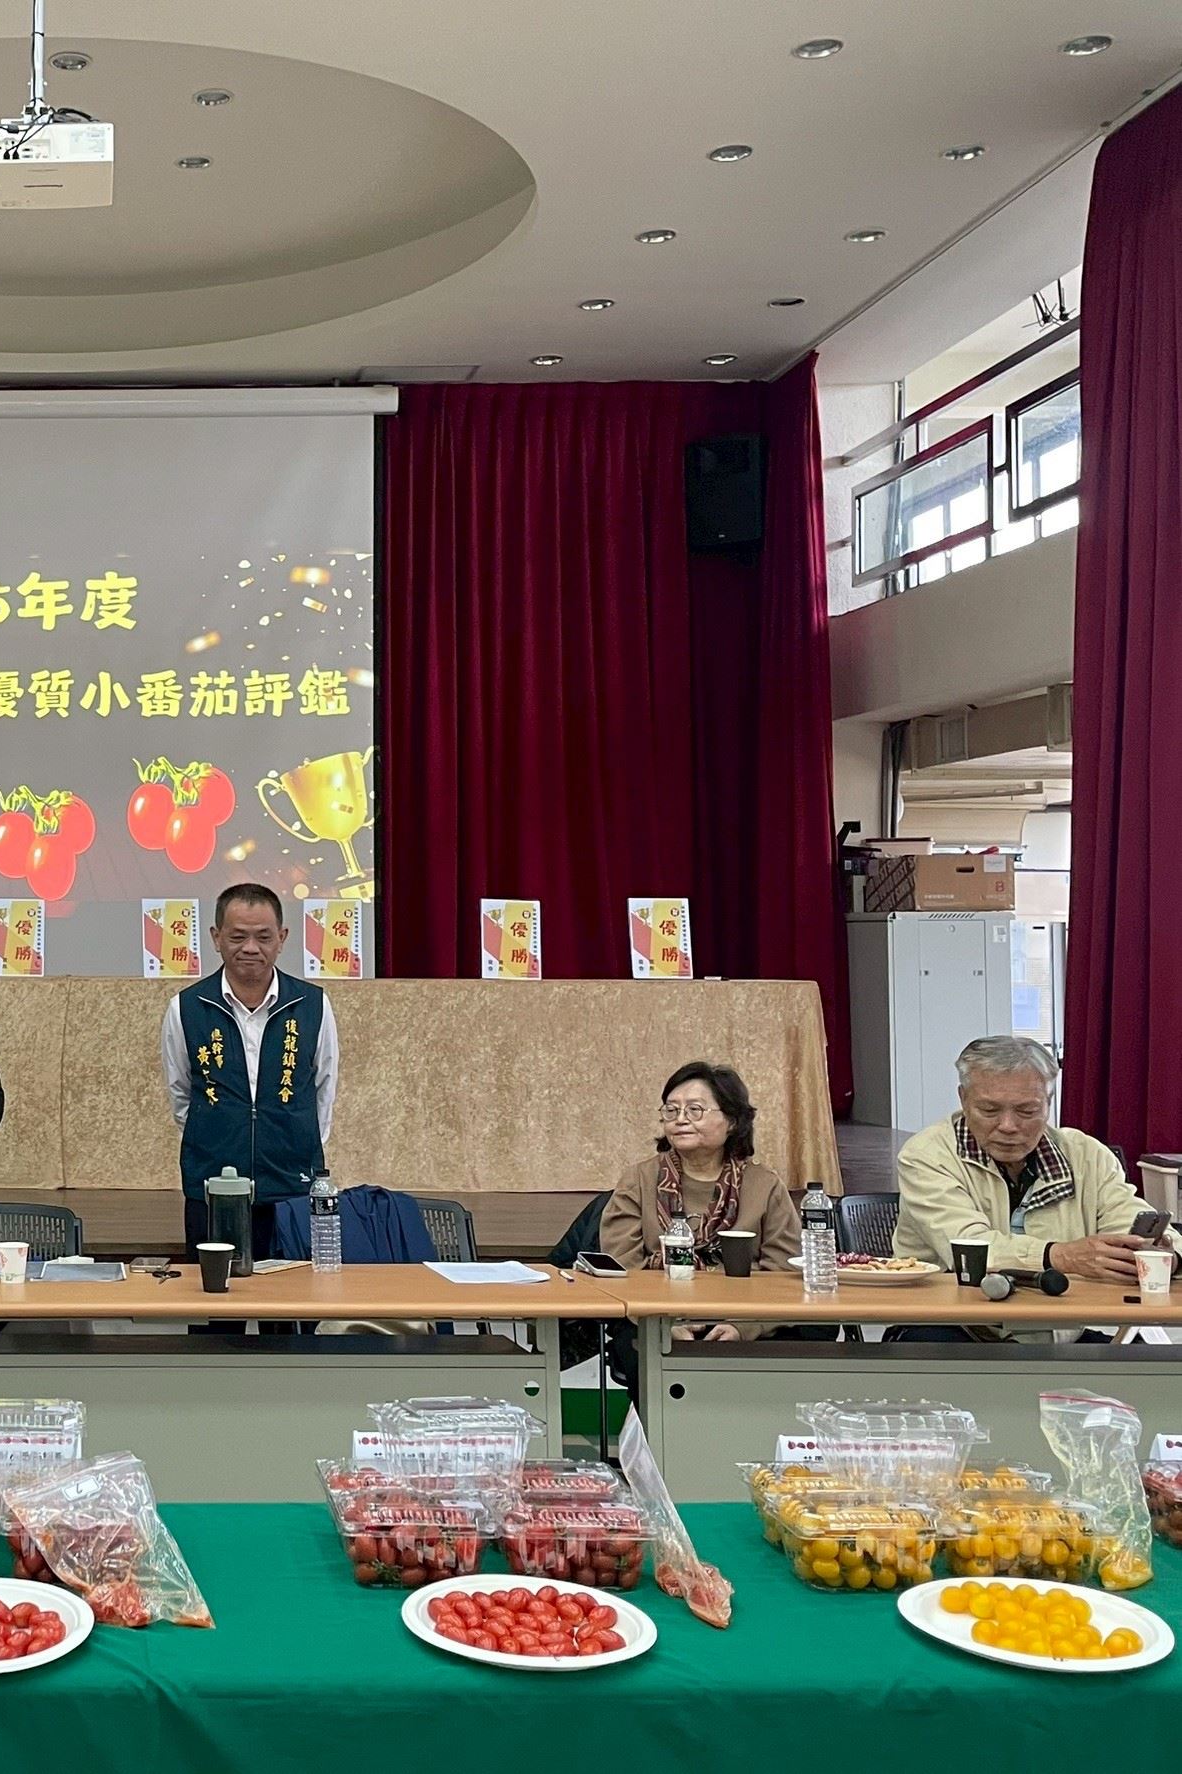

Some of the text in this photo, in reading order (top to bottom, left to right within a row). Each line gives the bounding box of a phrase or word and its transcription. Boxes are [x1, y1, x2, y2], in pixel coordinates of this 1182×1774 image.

[14, 919, 33, 961] 優勝
[169, 919, 189, 962] 優勝
[331, 919, 351, 963] 優勝
[509, 921, 529, 964] 優勝
[658, 919, 680, 963] 優勝
[278, 1018, 299, 1103] 後龍鎮農會
